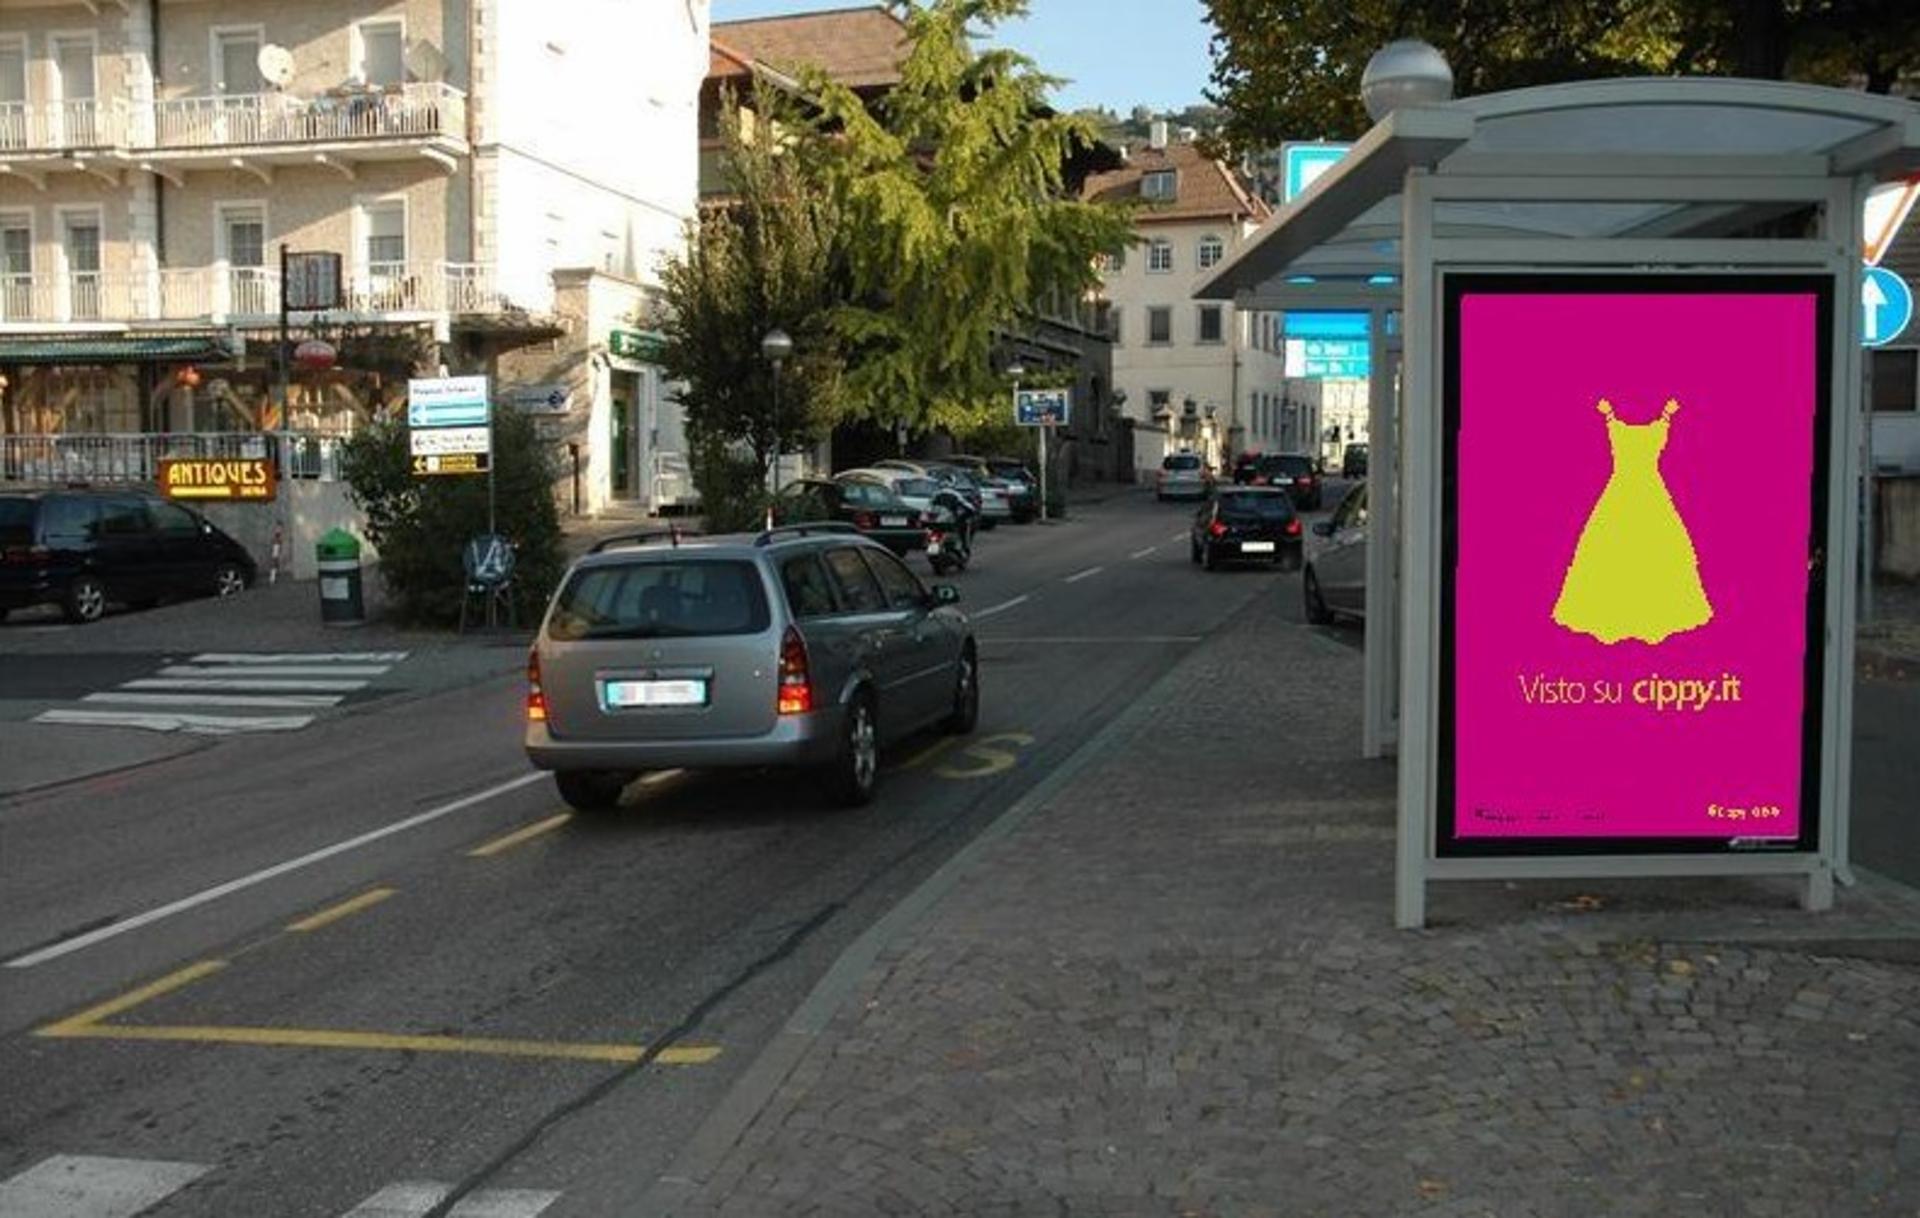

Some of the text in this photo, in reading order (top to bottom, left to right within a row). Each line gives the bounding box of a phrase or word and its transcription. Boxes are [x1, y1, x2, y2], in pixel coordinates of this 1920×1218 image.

[169, 462, 266, 485] ANTIQUES
[1518, 673, 1742, 711] Visto su cippy.it
